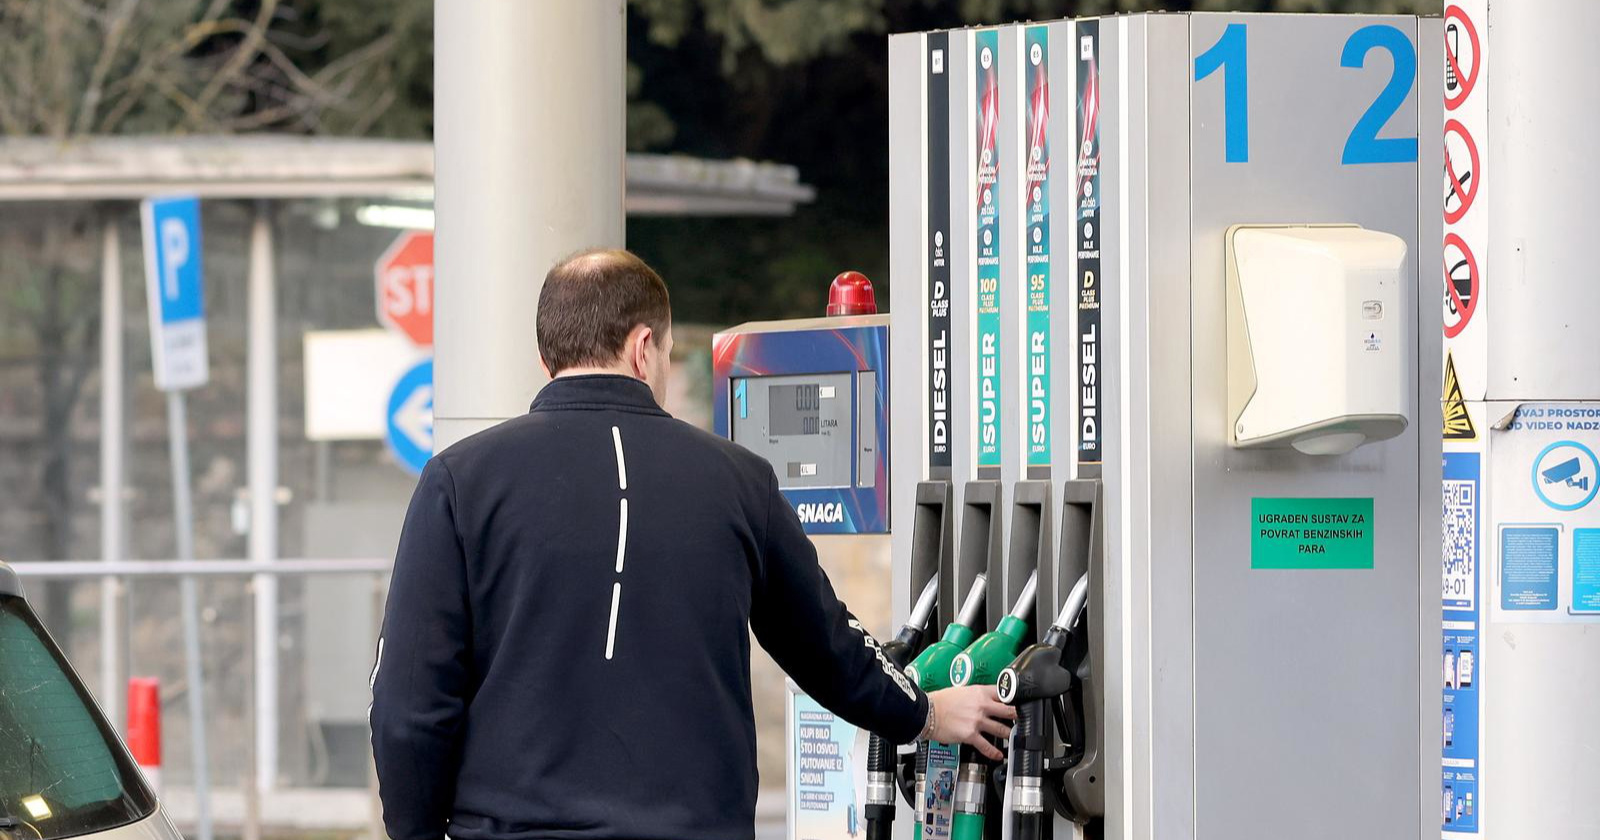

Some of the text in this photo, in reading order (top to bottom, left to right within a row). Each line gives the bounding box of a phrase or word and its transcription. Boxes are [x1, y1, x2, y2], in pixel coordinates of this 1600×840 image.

[1194, 23, 1419, 165] 1 2
[160, 217, 190, 301] P
[980, 278, 997, 293] 100
[1030, 274, 1045, 291] 95
[1083, 270, 1094, 288] D
[385, 265, 434, 316] ST
[934, 281, 945, 299] D
[1081, 289, 1096, 297] CLASS
[931, 300, 949, 309] CLASS
[932, 308, 947, 317] PLUS
[933, 330, 947, 444] DIESEL
[982, 333, 996, 445] SUPER
[1032, 331, 1046, 444] SUPER
[1082, 324, 1096, 441] DIESEL
[735, 379, 748, 419] 1
[1514, 408, 1545, 418] OVAJ
[821, 419, 838, 428] LITARA
[1526, 421, 1563, 431] VIDEO
[1566, 421, 1600, 431] NADZ
[934, 445, 947, 453] EURO
[1032, 445, 1045, 453] EURO
[1082, 442, 1096, 450] EURO
[796, 503, 843, 523] SNAGA
[1311, 514, 1349, 524] SUSTAV
[1351, 514, 1365, 524] ZA
[1260, 529, 1363, 539] POVRAT BENZINSKIH
[1298, 544, 1326, 554] PARA
[1442, 578, 1467, 595] 9-01
[801, 727, 830, 739] KUPI BILO
[801, 740, 813, 754] ŠTO
[801, 758, 843, 770] PUTOVANJE IZ
[801, 772, 823, 784] SNOVA!
